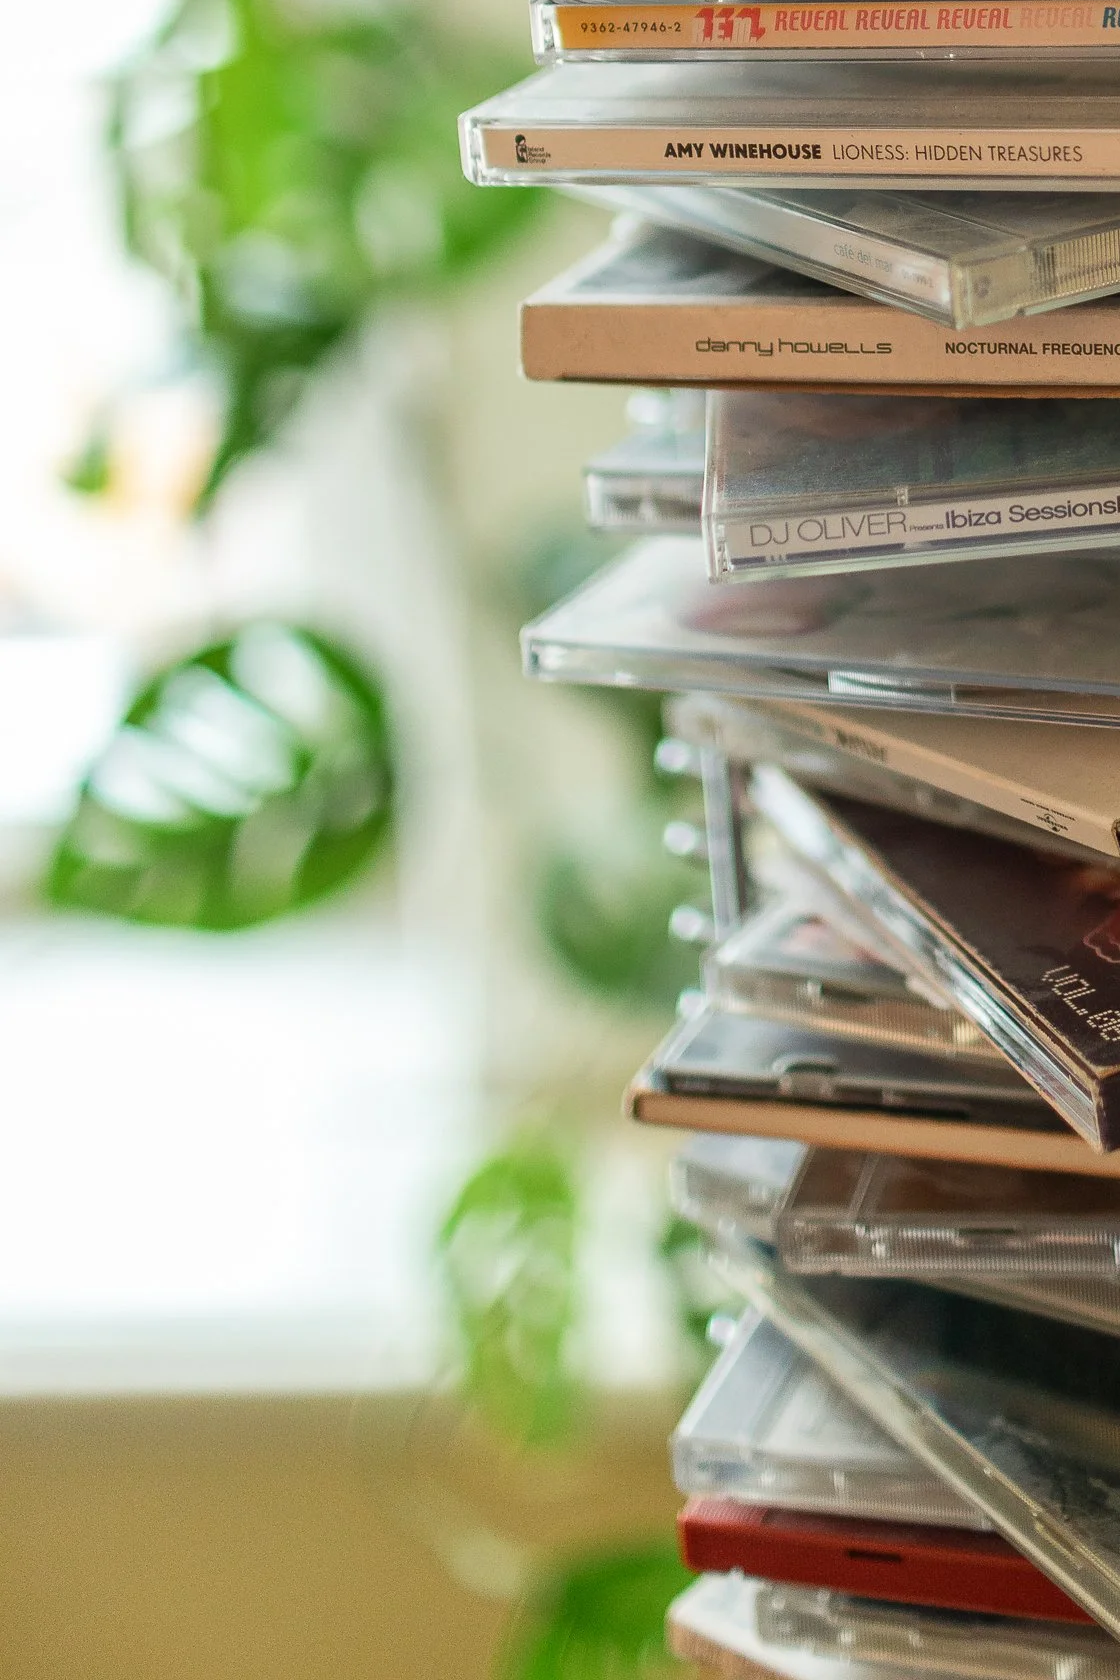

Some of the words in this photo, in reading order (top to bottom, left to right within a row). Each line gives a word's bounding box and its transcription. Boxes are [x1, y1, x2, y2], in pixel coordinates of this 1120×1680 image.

[580, 21, 682, 33] 9362-47946-2
[774, 9, 849, 31] REVEAL
[855, 8, 931, 31] REVEAL
[936, 7, 1013, 30] REVEAL
[1019, 6, 1096, 29] REVEAL
[664, 142, 704, 159] AMY
[709, 143, 822, 160] WINEHOUSE
[832, 144, 909, 161] LIONESS:
[914, 145, 982, 161] HIDDEN
[987, 145, 1083, 162] TREASURES
[857, 249, 872, 266] del
[695, 337, 773, 357] danny
[945, 341, 1038, 355] NOCTURNAL
[750, 521, 790, 547] DJ
[797, 510, 907, 542] OLIVER
[944, 509, 1002, 529] Ibiza
